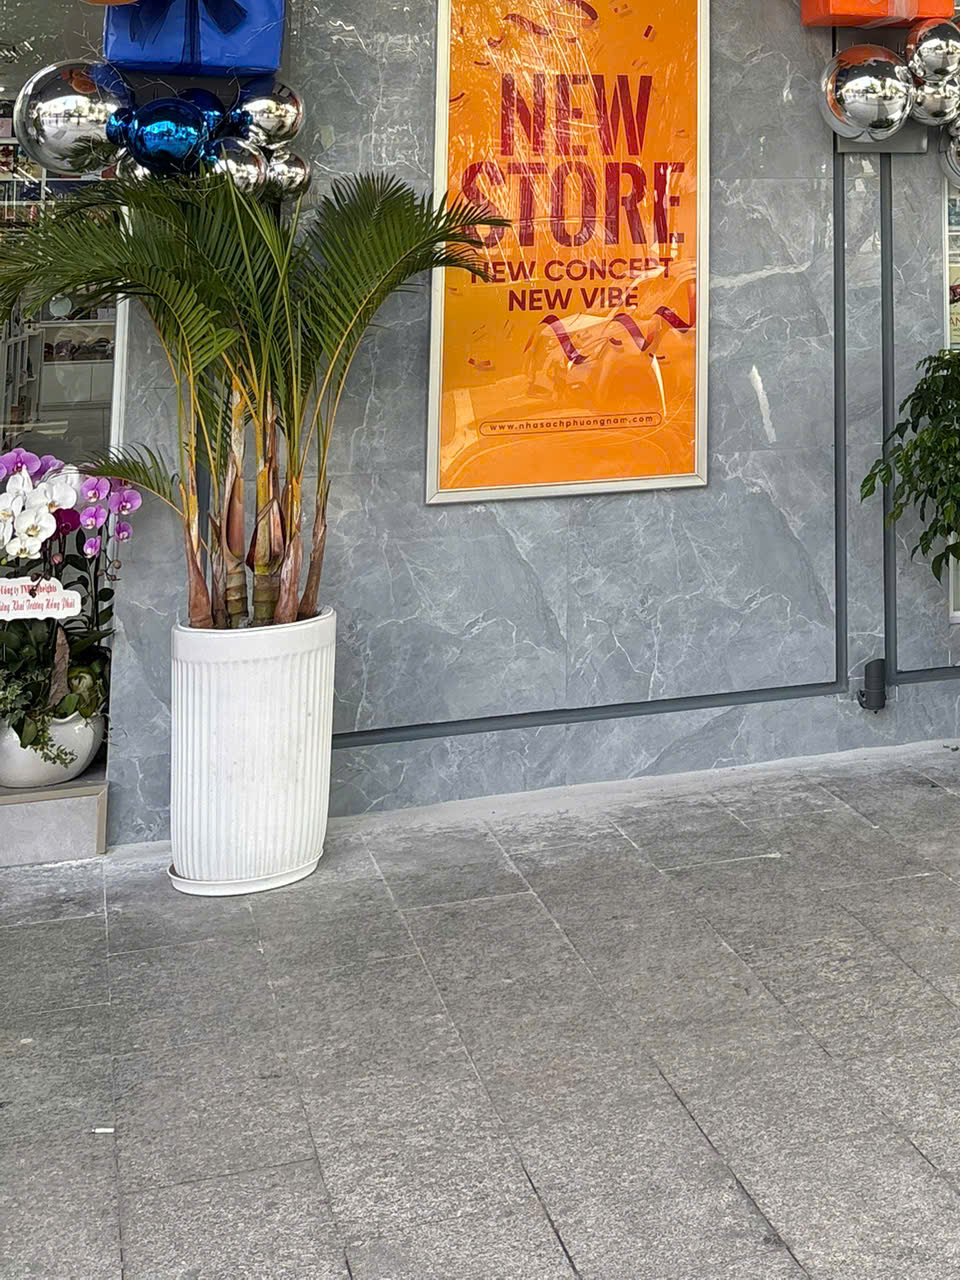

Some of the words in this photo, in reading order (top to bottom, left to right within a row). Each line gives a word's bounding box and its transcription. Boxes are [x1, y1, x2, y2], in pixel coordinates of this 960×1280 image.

[500, 73, 653, 156] NEW
[461, 160, 686, 248] STORE
[544, 257, 673, 282] CONCEPT
[508, 287, 573, 312] NEW
[580, 286, 639, 309] VIBE
[488, 414, 654, 432] www.nhasachphuongnam.com
